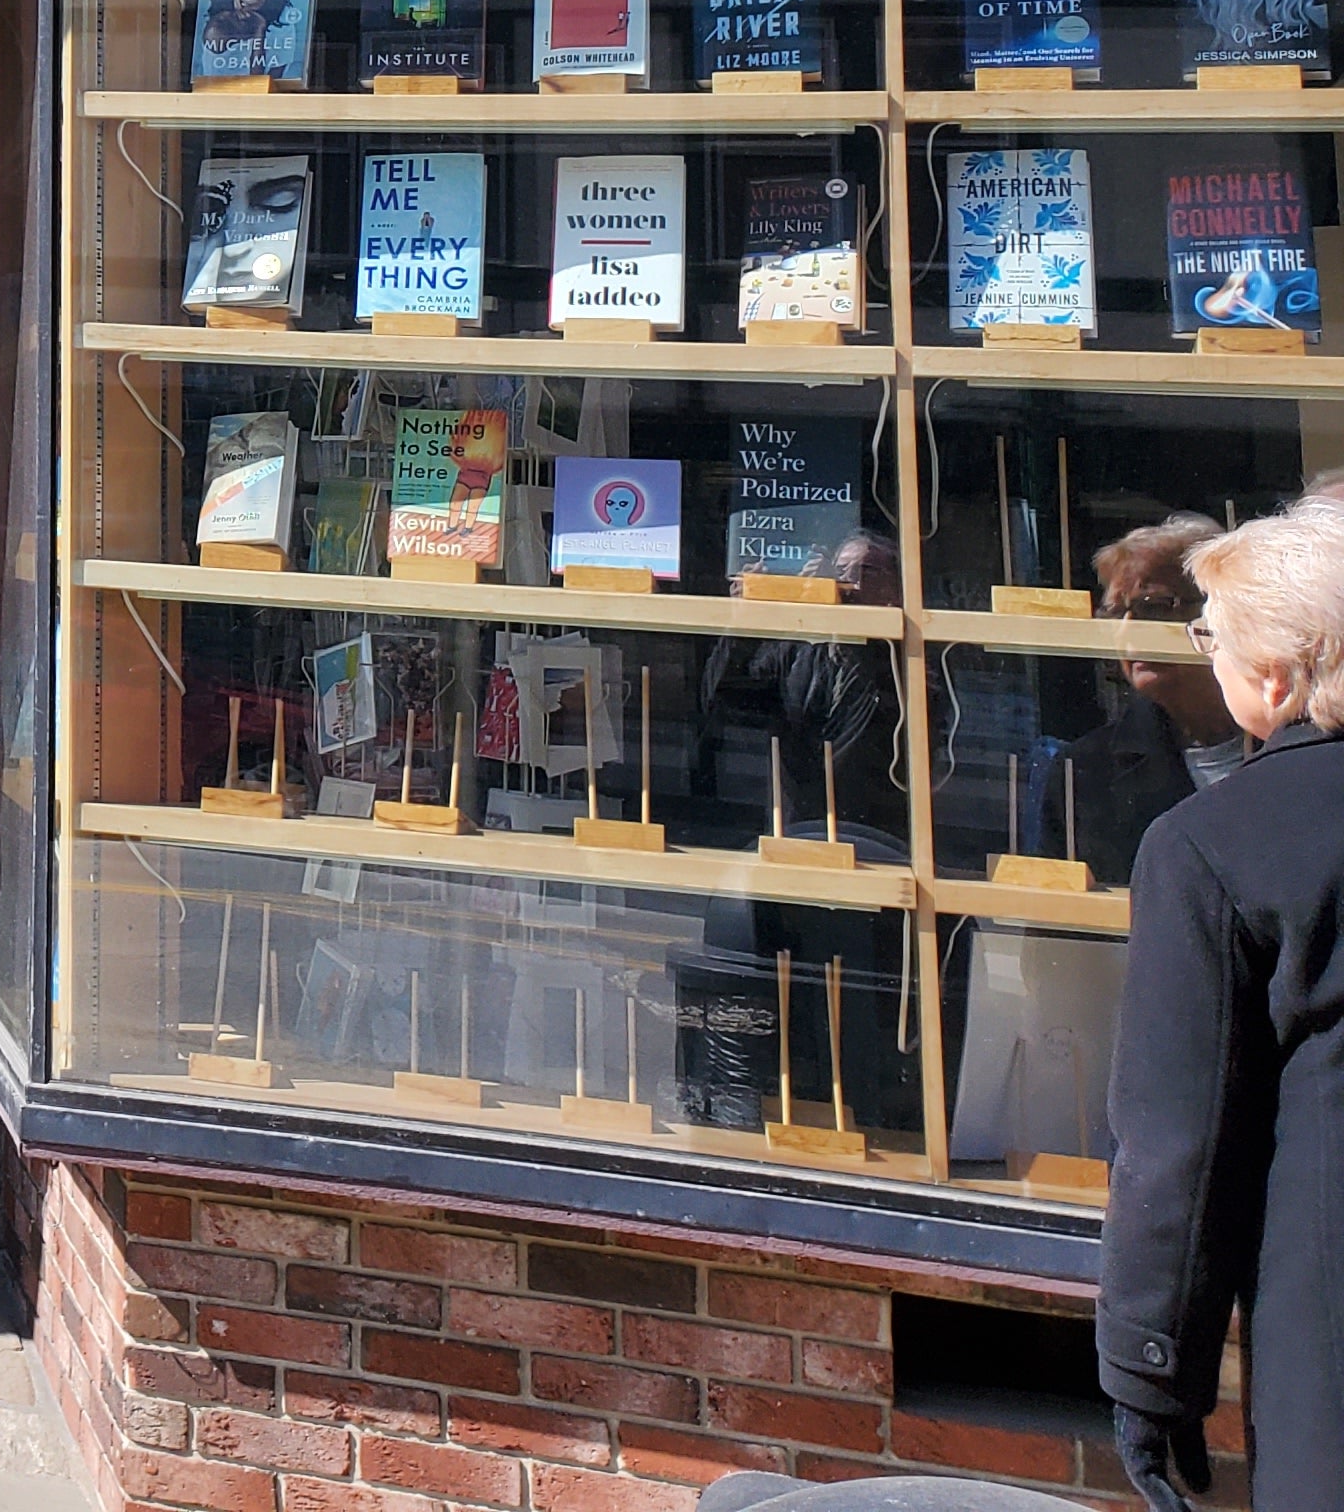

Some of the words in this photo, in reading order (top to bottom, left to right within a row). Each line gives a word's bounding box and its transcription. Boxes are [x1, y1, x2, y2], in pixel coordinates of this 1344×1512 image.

[978, 2, 1010, 17] OF
[716, 11, 800, 41] RIVER
[1232, 24, 1269, 46] Open
[1269, 23, 1310, 41] Book
[203, 36, 293, 52] MICHELLE
[213, 54, 280, 70] OBAMA
[368, 51, 470, 67] INSTITUTE
[543, 53, 579, 66] COLSON
[584, 51, 635, 65] WHITEHEAD
[717, 54, 741, 68] LIZ
[746, 50, 801, 67] MOORE
[1194, 50, 1251, 62] JESSICA
[1254, 49, 1318, 60] SIMPSON
[372, 159, 436, 183] TELL
[581, 181, 656, 202] three
[750, 184, 819, 201] Writers
[966, 177, 1073, 199] AMERICAN
[1169, 172, 1300, 204] MICHAEL
[370, 188, 418, 211] ME
[769, 201, 831, 218] Lovers
[200, 211, 225, 229] My
[233, 209, 275, 225] Dark
[567, 212, 667, 230] women
[748, 219, 777, 238] Lily
[783, 217, 823, 236] King
[1170, 205, 1302, 238] CONNELLY
[367, 237, 468, 260] EVERY
[994, 232, 1046, 255] DIRT
[590, 255, 640, 276] lisa
[1173, 251, 1206, 275] THE
[1211, 249, 1265, 274] NIGHT
[1268, 248, 1307, 272] FIRE
[364, 266, 468, 290] THING
[417, 295, 471, 305] CAMBRIA
[568, 286, 661, 307] taddeo
[964, 292, 1014, 306] JEANINE
[1022, 293, 1079, 306] CUMMINS
[404, 304, 471, 314] BROCKMAN
[402, 418, 485, 439] Nothing
[740, 423, 796, 448] Why
[222, 451, 264, 463] Weather
[400, 442, 420, 457] to
[427, 440, 465, 457] See
[398, 462, 448, 481] Here
[740, 450, 806, 472] We're
[740, 478, 852, 503] Polarized
[212, 515, 236, 524] Jenny
[393, 512, 447, 532] Kevin
[740, 509, 794, 531] Ezra
[393, 536, 463, 557] Wilson
[739, 537, 803, 560] Klein
